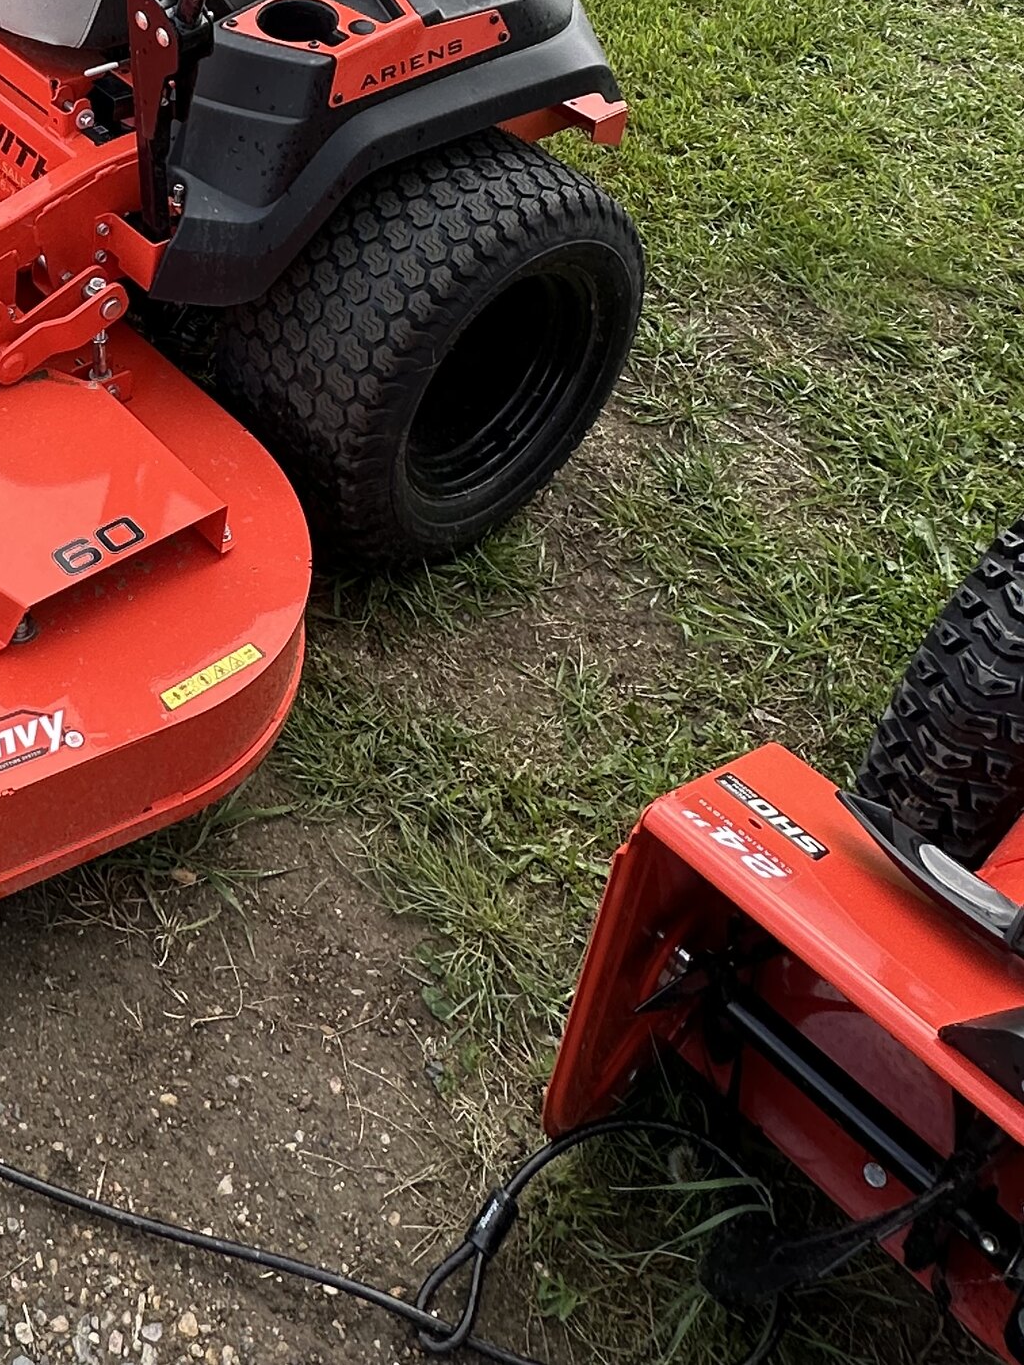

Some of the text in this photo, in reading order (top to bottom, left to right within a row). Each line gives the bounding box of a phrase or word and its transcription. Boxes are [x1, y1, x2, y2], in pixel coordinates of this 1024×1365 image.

[360, 38, 464, 91] ARIENS
[53, 517, 145, 574] 60
[698, 798, 793, 875] CLEARING WIDTH
[747, 798, 826, 854] SHO
